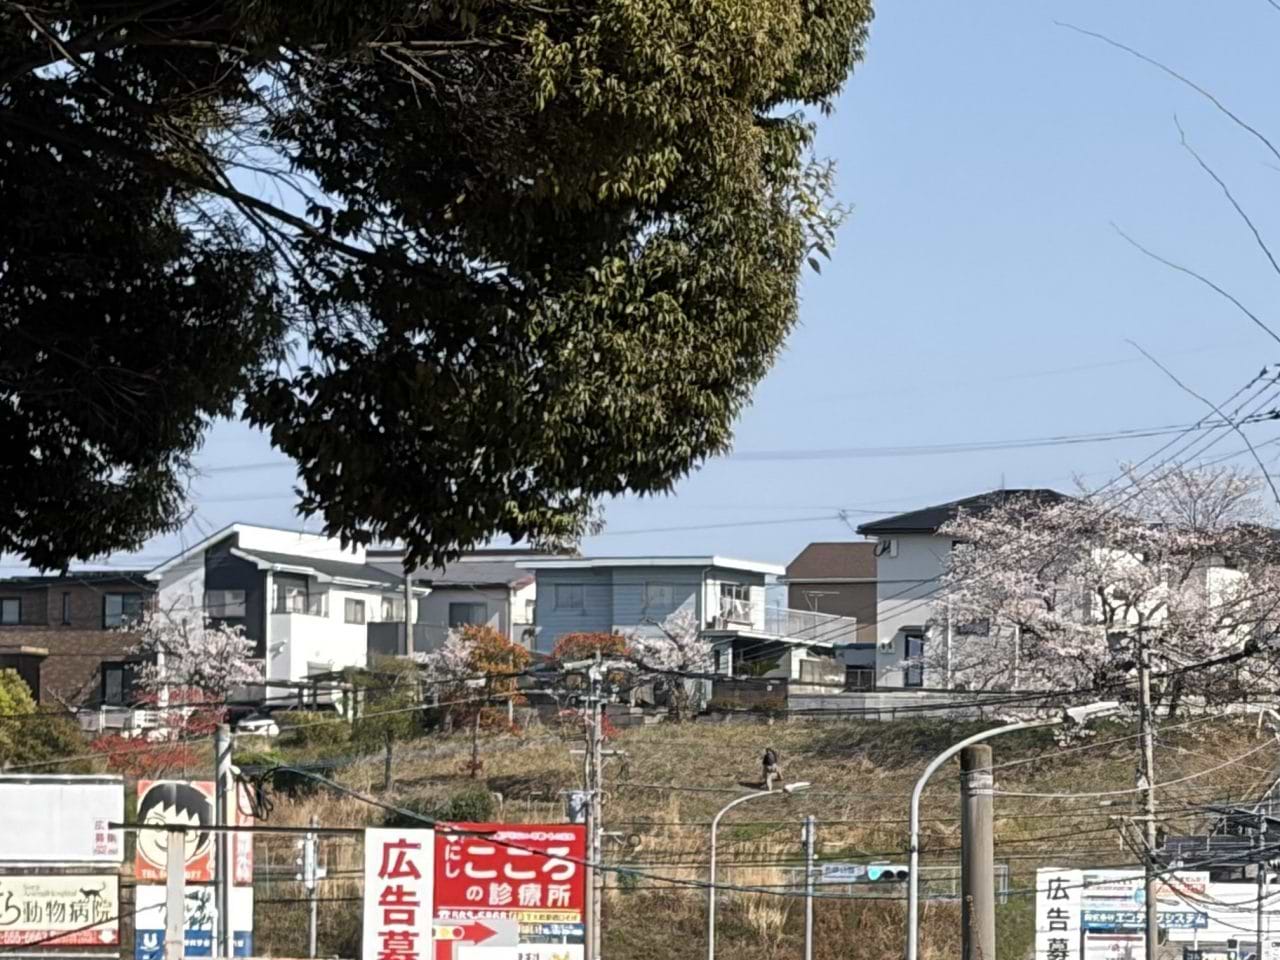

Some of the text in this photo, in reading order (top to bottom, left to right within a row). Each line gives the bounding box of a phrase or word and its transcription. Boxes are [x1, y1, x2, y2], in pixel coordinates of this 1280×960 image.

[464, 846, 576, 881] こころ
[466, 882, 571, 907] の診療所
